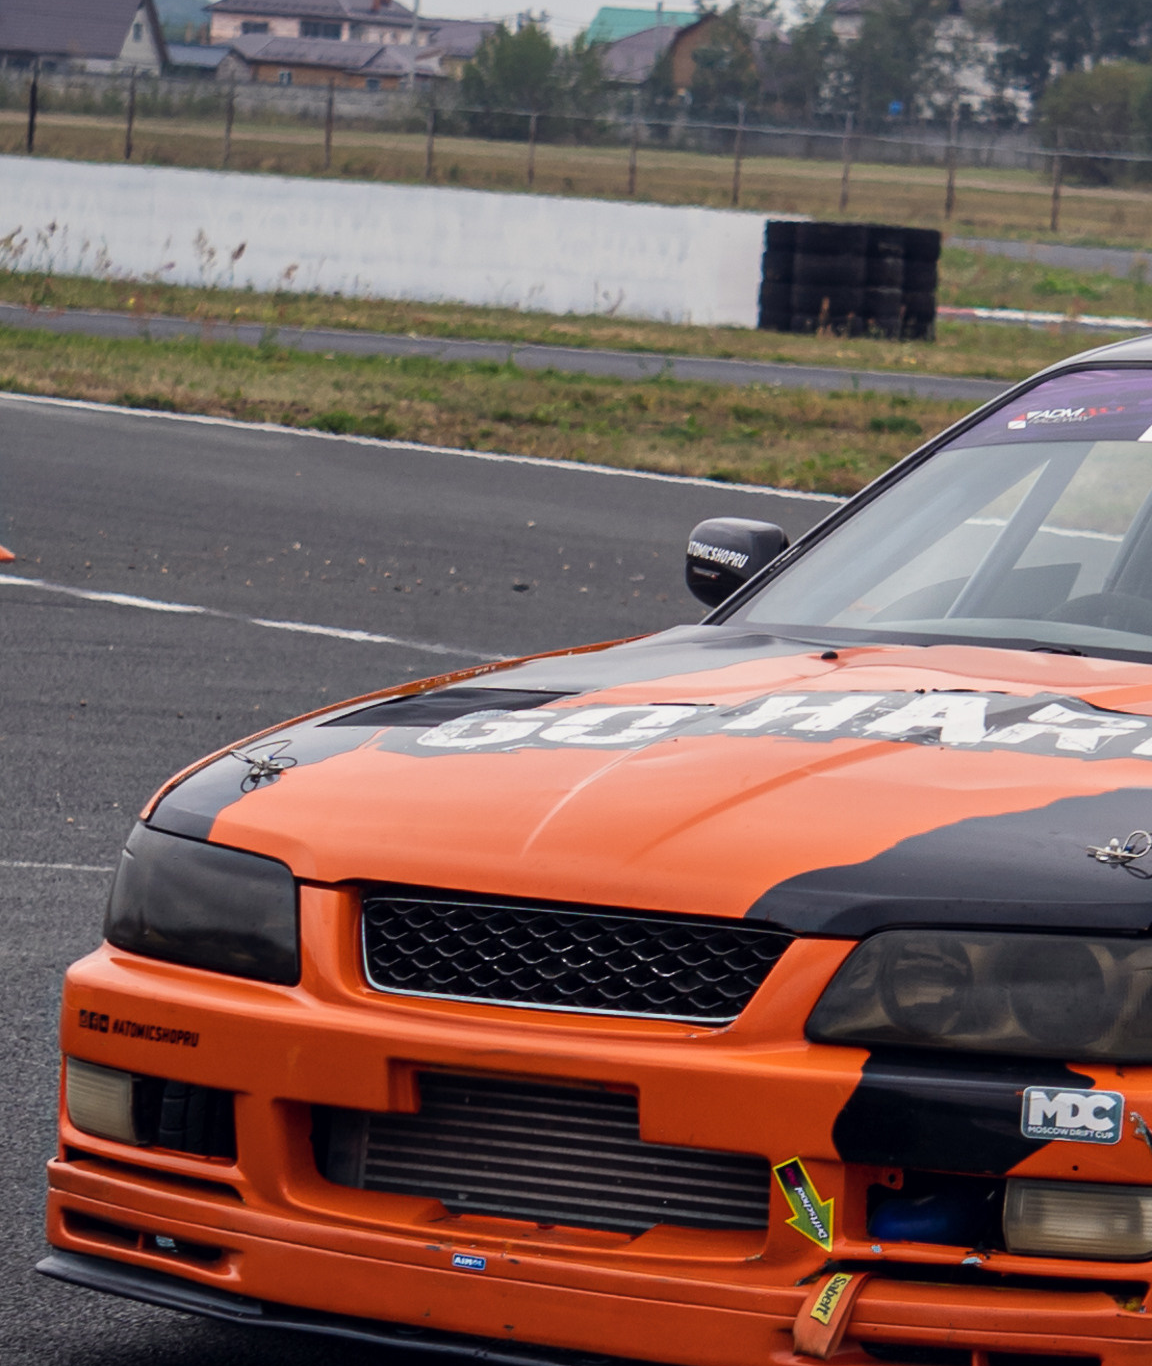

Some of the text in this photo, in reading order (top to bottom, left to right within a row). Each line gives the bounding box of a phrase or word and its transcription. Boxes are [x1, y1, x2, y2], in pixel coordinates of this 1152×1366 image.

[416, 704, 697, 749] GO
[1028, 1091, 1117, 1131] MDC
[1028, 1125, 1114, 1140] MOSCOW DRIFT CUP
[816, 1276, 848, 1317] Sabelt
